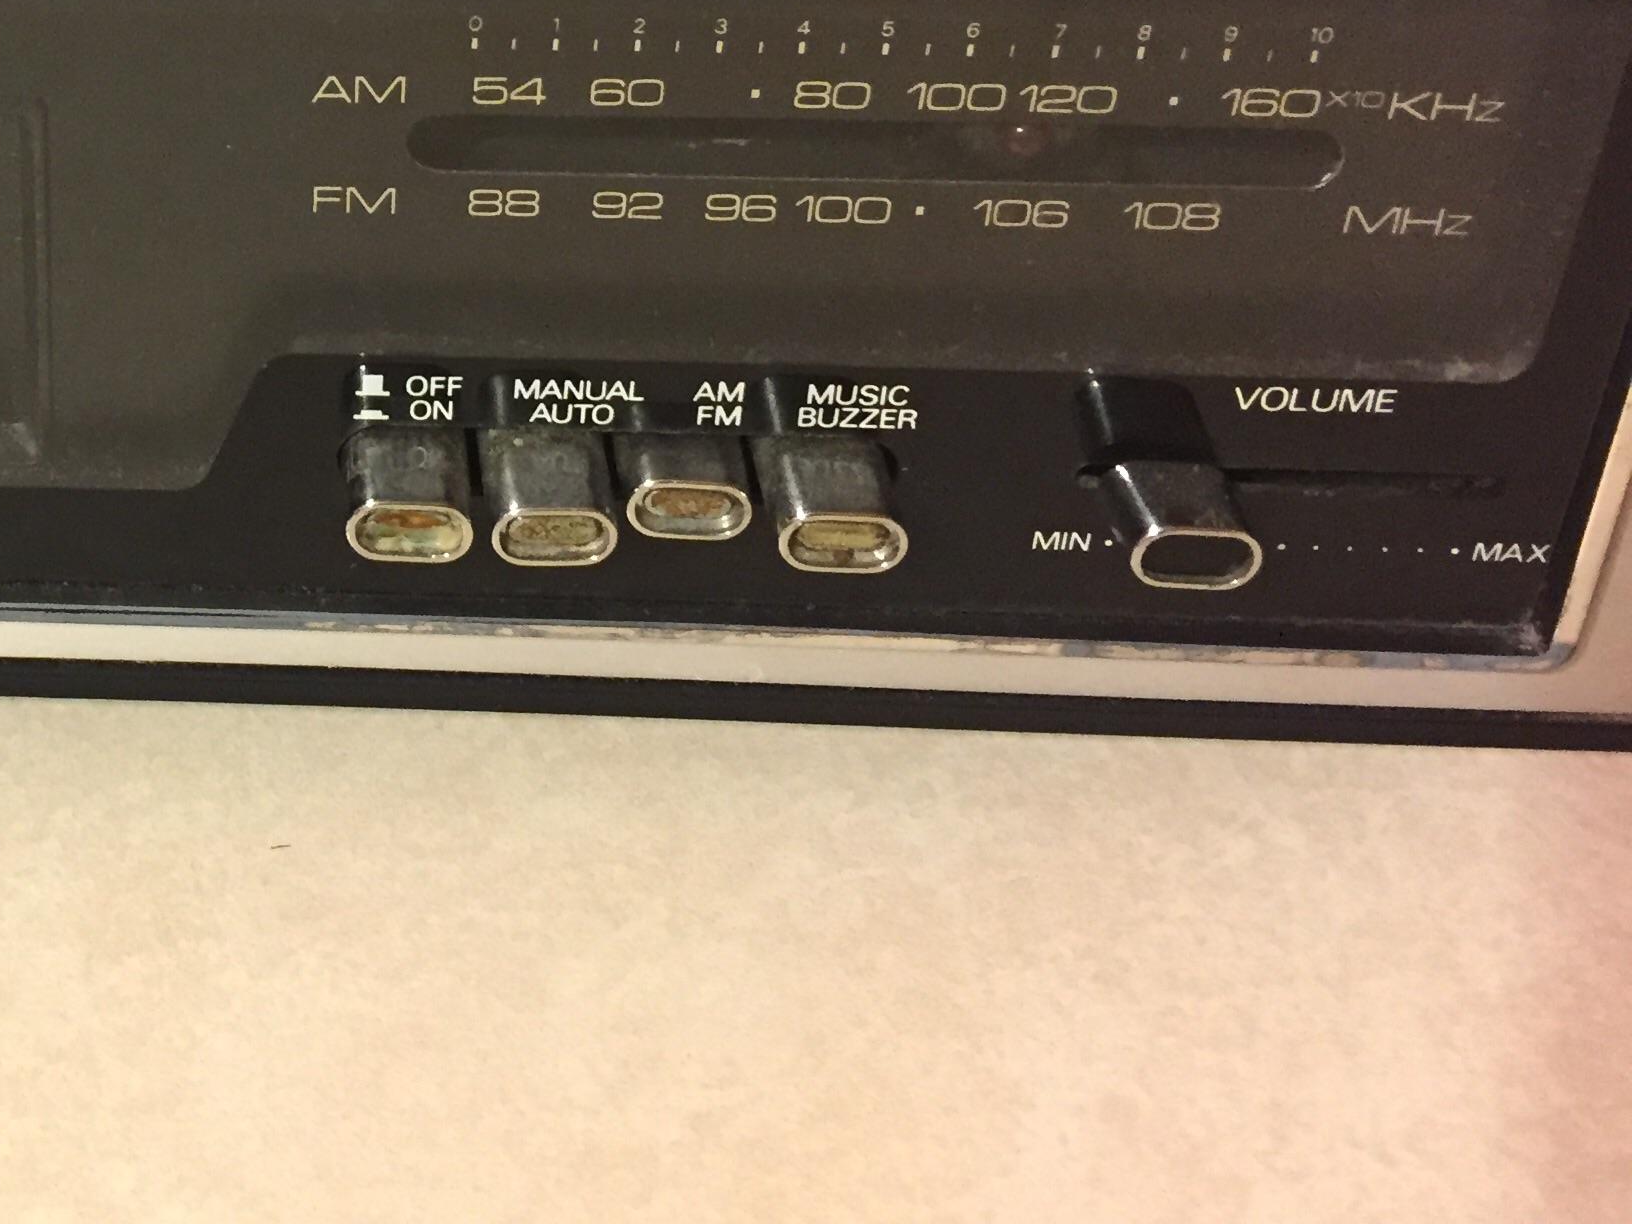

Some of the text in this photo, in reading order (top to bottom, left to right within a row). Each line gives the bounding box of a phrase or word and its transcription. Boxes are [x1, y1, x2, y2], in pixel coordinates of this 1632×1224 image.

[469, 15, 1335, 44] 0 1 2 3 4 5 6 7 8 9 10
[312, 76, 406, 104] AM
[472, 77, 546, 105] 54
[590, 78, 665, 106] 60
[793, 81, 871, 110] 80
[906, 82, 1007, 111] 100
[1019, 85, 1118, 114] 120
[1221, 88, 1322, 118] 160
[1387, 92, 1506, 122] KHz
[312, 186, 1473, 234] FM 88 92 96 100 106 108 MHz
[406, 376, 464, 397] OFF
[513, 379, 645, 403] MANUAL
[693, 381, 746, 403] AM
[806, 384, 910, 407] MUSIC
[409, 400, 454, 421] ON
[1234, 386, 1399, 414] VOLUME
[528, 403, 615, 426] AUTO
[696, 405, 744, 427] FM
[796, 407, 919, 431] BUZZER
[1030, 531, 1092, 552] MIN
[1470, 543, 1550, 564] MAX
